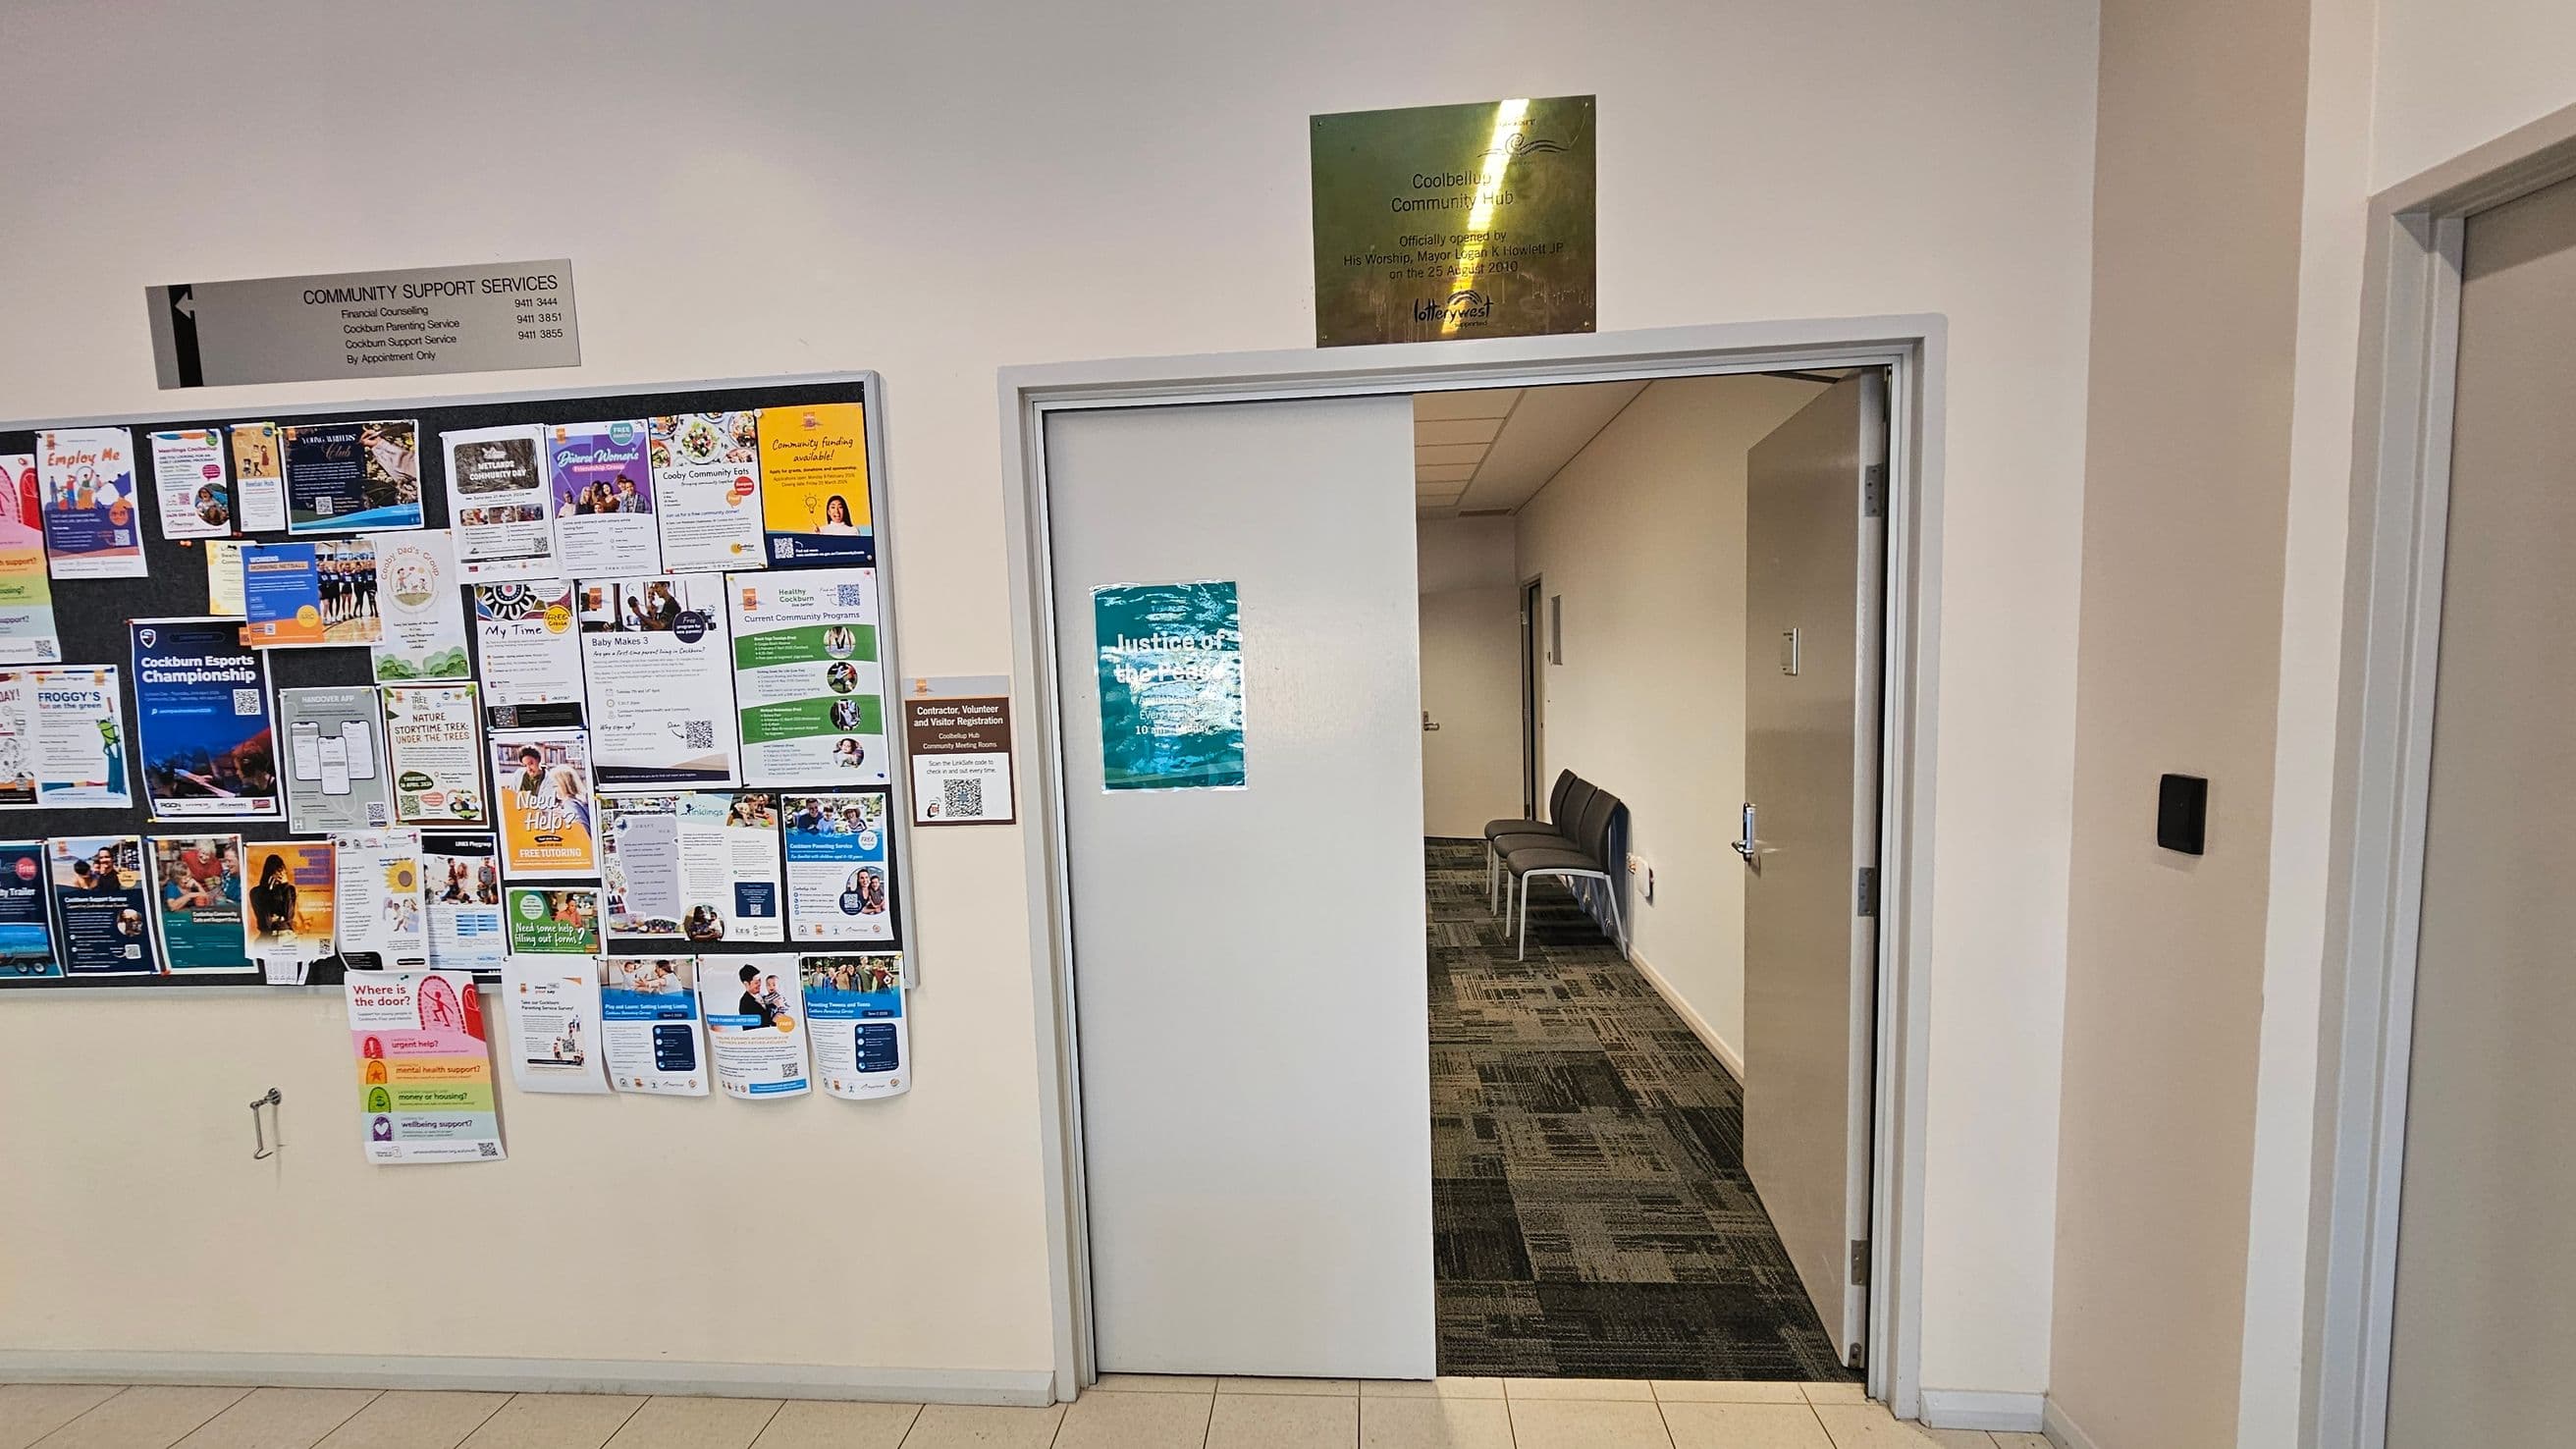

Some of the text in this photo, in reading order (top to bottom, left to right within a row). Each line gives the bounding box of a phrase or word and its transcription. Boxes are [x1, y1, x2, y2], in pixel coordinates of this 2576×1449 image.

[1413, 170, 1491, 188] Coolbellup
[1391, 190, 1514, 213] Community Hub
[1400, 230, 1507, 247] Officially opened by
[1344, 242, 1564, 266] His Worship, Mayor Logan K Howlett JP
[1389, 261, 1519, 280] on the 25 August 2010
[303, 275, 558, 304] COMMUNITY SUPPORT SERVICES
[514, 297, 558, 307] 9411 3444
[342, 306, 429, 319] Financial Counselling
[1414, 296, 1494, 323] lotterywest
[516, 313, 562, 324] 9411 3851
[343, 319, 460, 334] Cockburn Parenting Service
[517, 329, 564, 340] 9411 3855
[345, 334, 456, 349] Cockburn Support Service
[347, 349, 436, 365] By Appointment Only
[772, 436, 853, 451] Community funding
[47, 448, 121, 469] Employ Me
[793, 450, 834, 462] available!
[663, 471, 686, 481] Cooby
[688, 466, 731, 479] Community
[6, 558, 37, 567] support?
[778, 588, 806, 598] Healthy
[778, 595, 815, 604] Cockburn
[744, 610, 861, 623] Current Community Programs
[485, 623, 543, 639] My Time
[591, 636, 649, 648] Baby Makes 3
[1117, 627, 1226, 655] Justice of
[140, 655, 255, 668] Cockburn Esports
[141, 667, 256, 684] Championship
[1113, 665, 1154, 683] the
[37, 691, 101, 702] FROGGY'S
[301, 694, 354, 704] HANDOVER APP
[917, 705, 999, 716] Contractor, Volunteer
[412, 712, 447, 723] NATURE
[931, 717, 955, 726] Visitor
[957, 716, 1003, 726] Registration
[395, 722, 469, 735] STORYTIME TREK:
[1135, 724, 1149, 735] 10
[396, 731, 470, 744] UNDER THE TREES
[515, 791, 559, 811] Need
[524, 812, 576, 833] Help?
[519, 847, 582, 858] FREE TUTORING
[10, 886, 35, 896] Trailer
[515, 923, 574, 934] Need some help
[514, 933, 537, 946] filling
[538, 934, 552, 943] out
[353, 983, 406, 994] Where is
[355, 995, 410, 1007] the door?
[392, 1040, 439, 1049] urgent help?
[447, 1065, 481, 1074] support?
[433, 1092, 468, 1101] housing?
[402, 1119, 473, 1129] wellbeing support?
